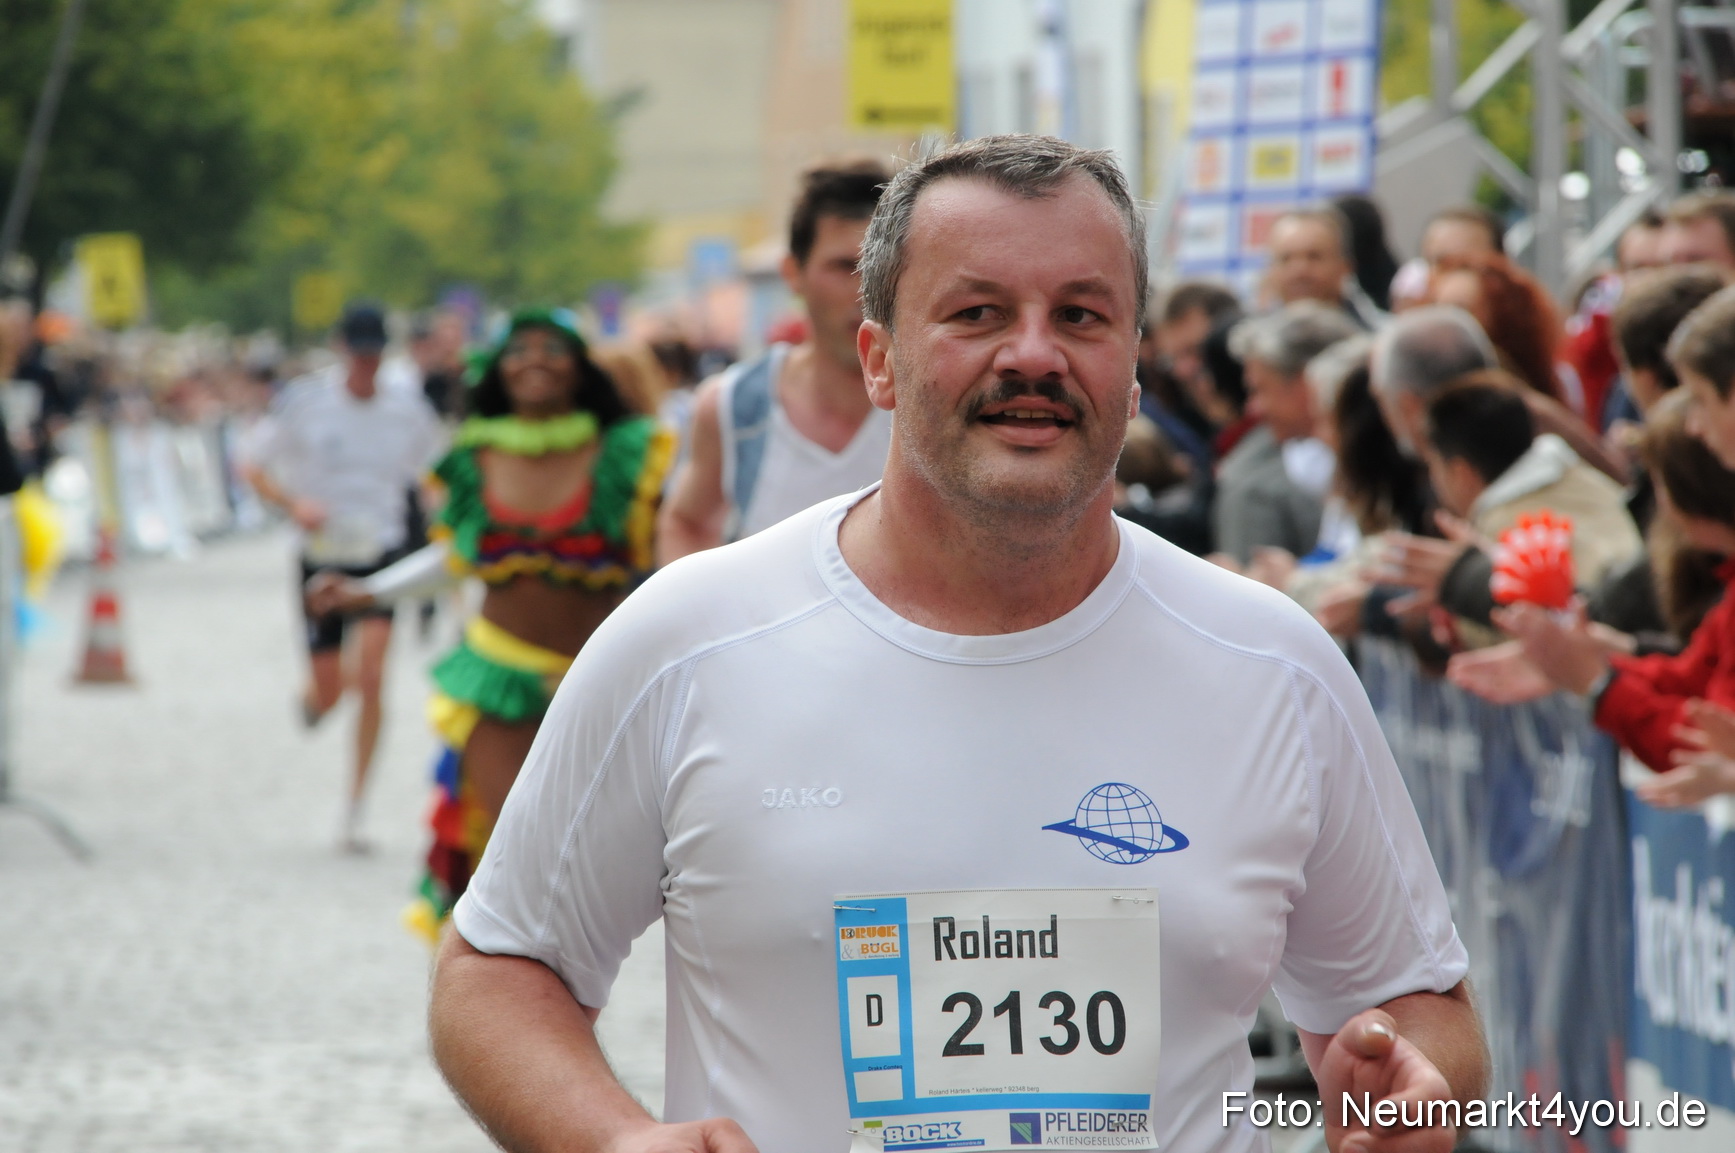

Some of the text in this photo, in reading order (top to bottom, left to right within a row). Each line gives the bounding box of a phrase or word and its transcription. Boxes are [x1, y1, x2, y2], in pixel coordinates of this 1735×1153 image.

[761, 787, 843, 809] JAKO
[861, 942, 899, 955] BÖGL
[933, 914, 1058, 961] Roland
[866, 994, 883, 1027] D
[941, 990, 1126, 1057] 2130
[883, 1121, 962, 1143] BOCK
[1045, 1112, 1148, 1132] PFLEIDERER
[1046, 1136, 1151, 1147] AKTIENGESELLSCHAFT
